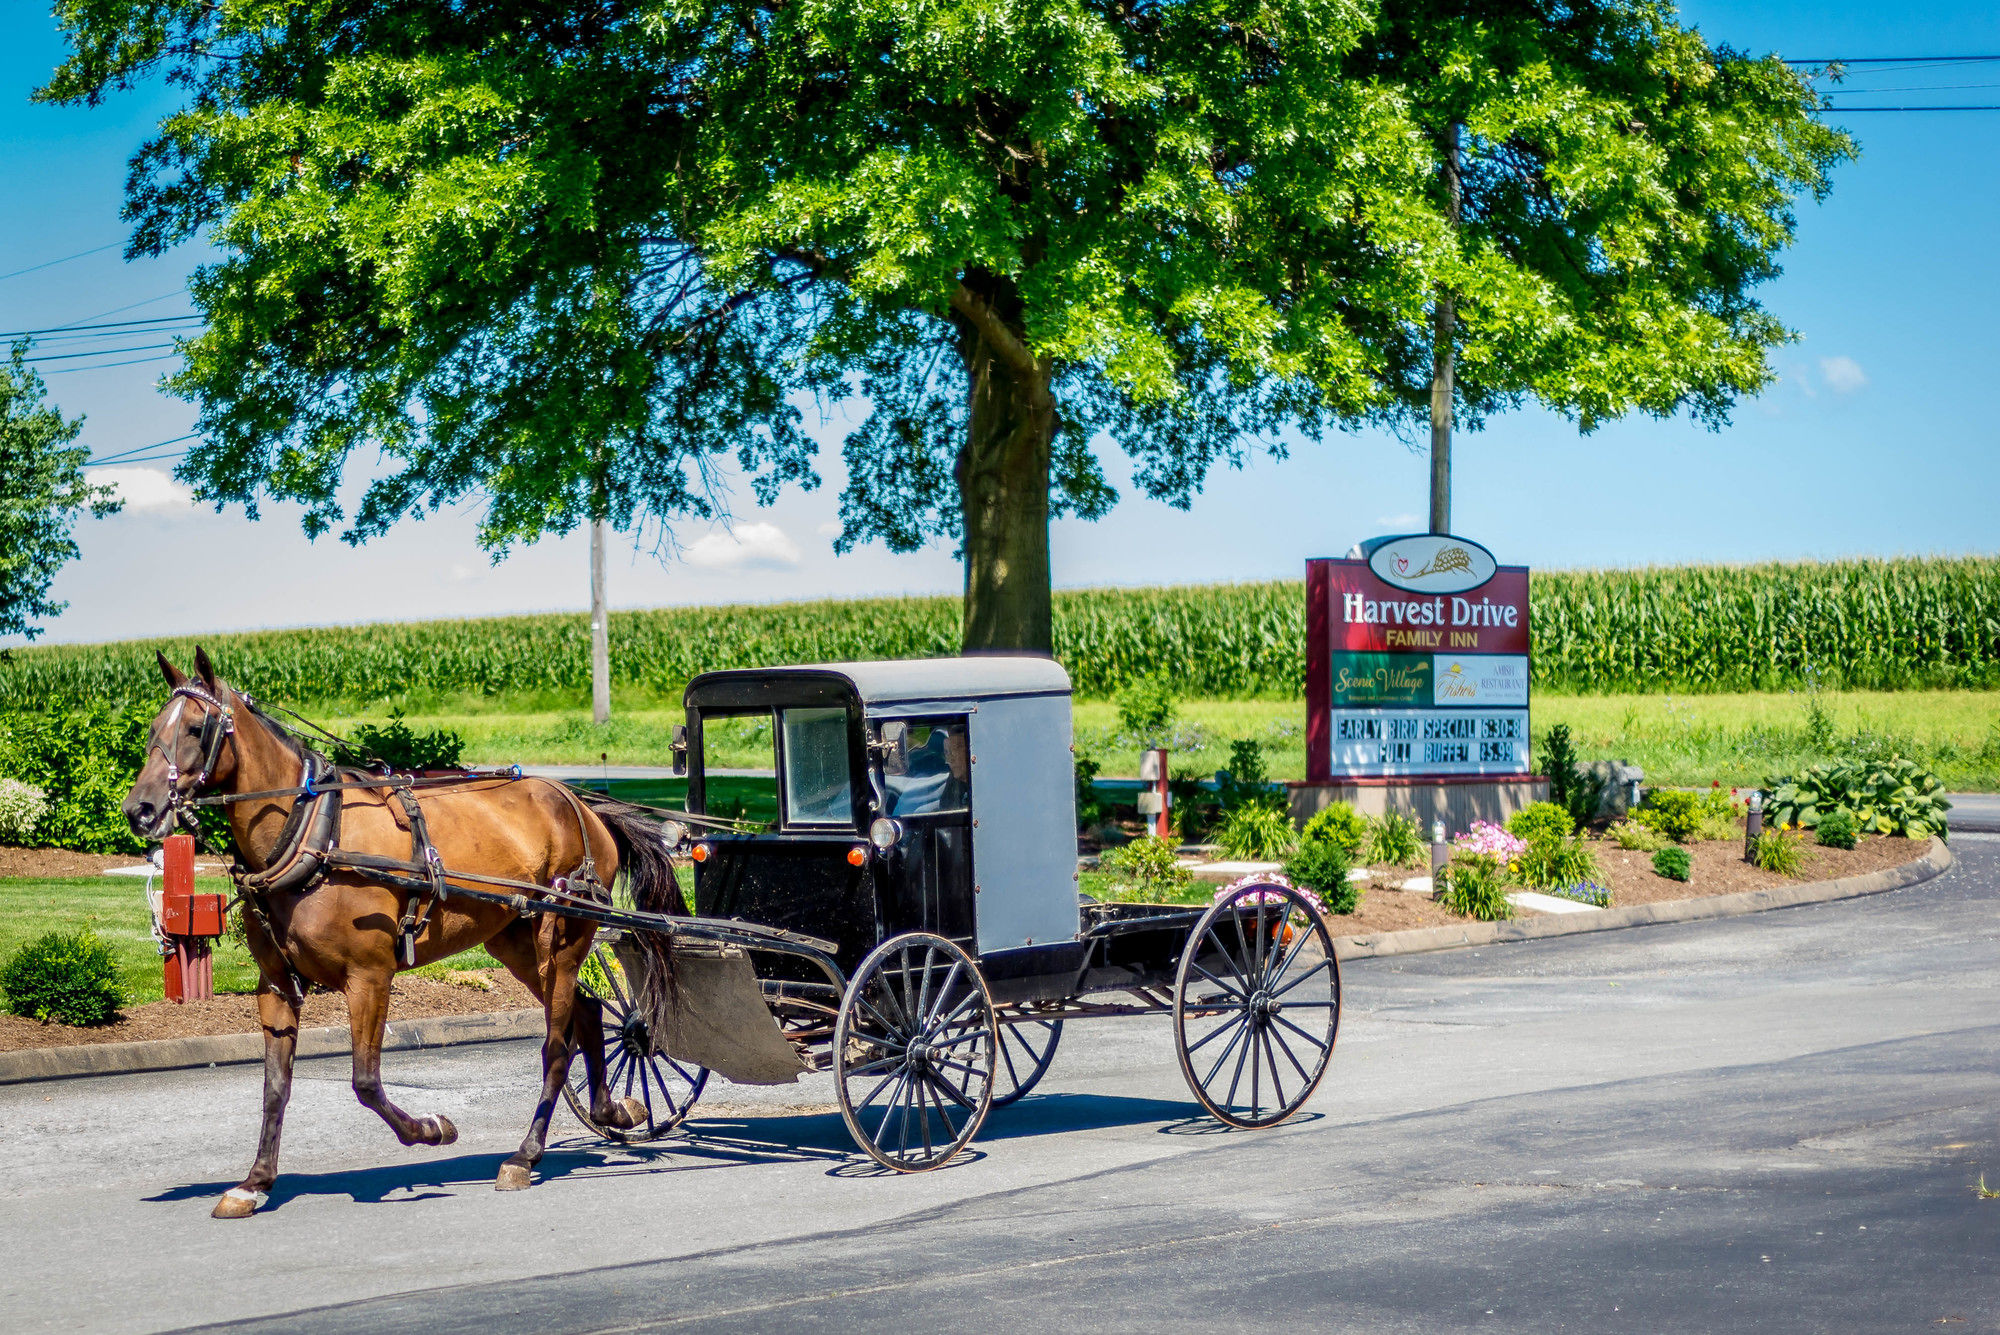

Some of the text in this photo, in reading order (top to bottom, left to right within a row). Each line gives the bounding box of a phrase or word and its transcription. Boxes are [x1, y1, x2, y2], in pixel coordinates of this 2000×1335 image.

[1342, 593, 1518, 628] Harvest Drive
[1386, 629, 1479, 648] FAMILY INN
[1335, 667, 1424, 695] Scenic Village
[1481, 679, 1525, 690] RESTAURANT
[1338, 719, 1520, 739] EARLY BIRD SPECIAL 6:30-8
[1379, 743, 1410, 763] FULL
